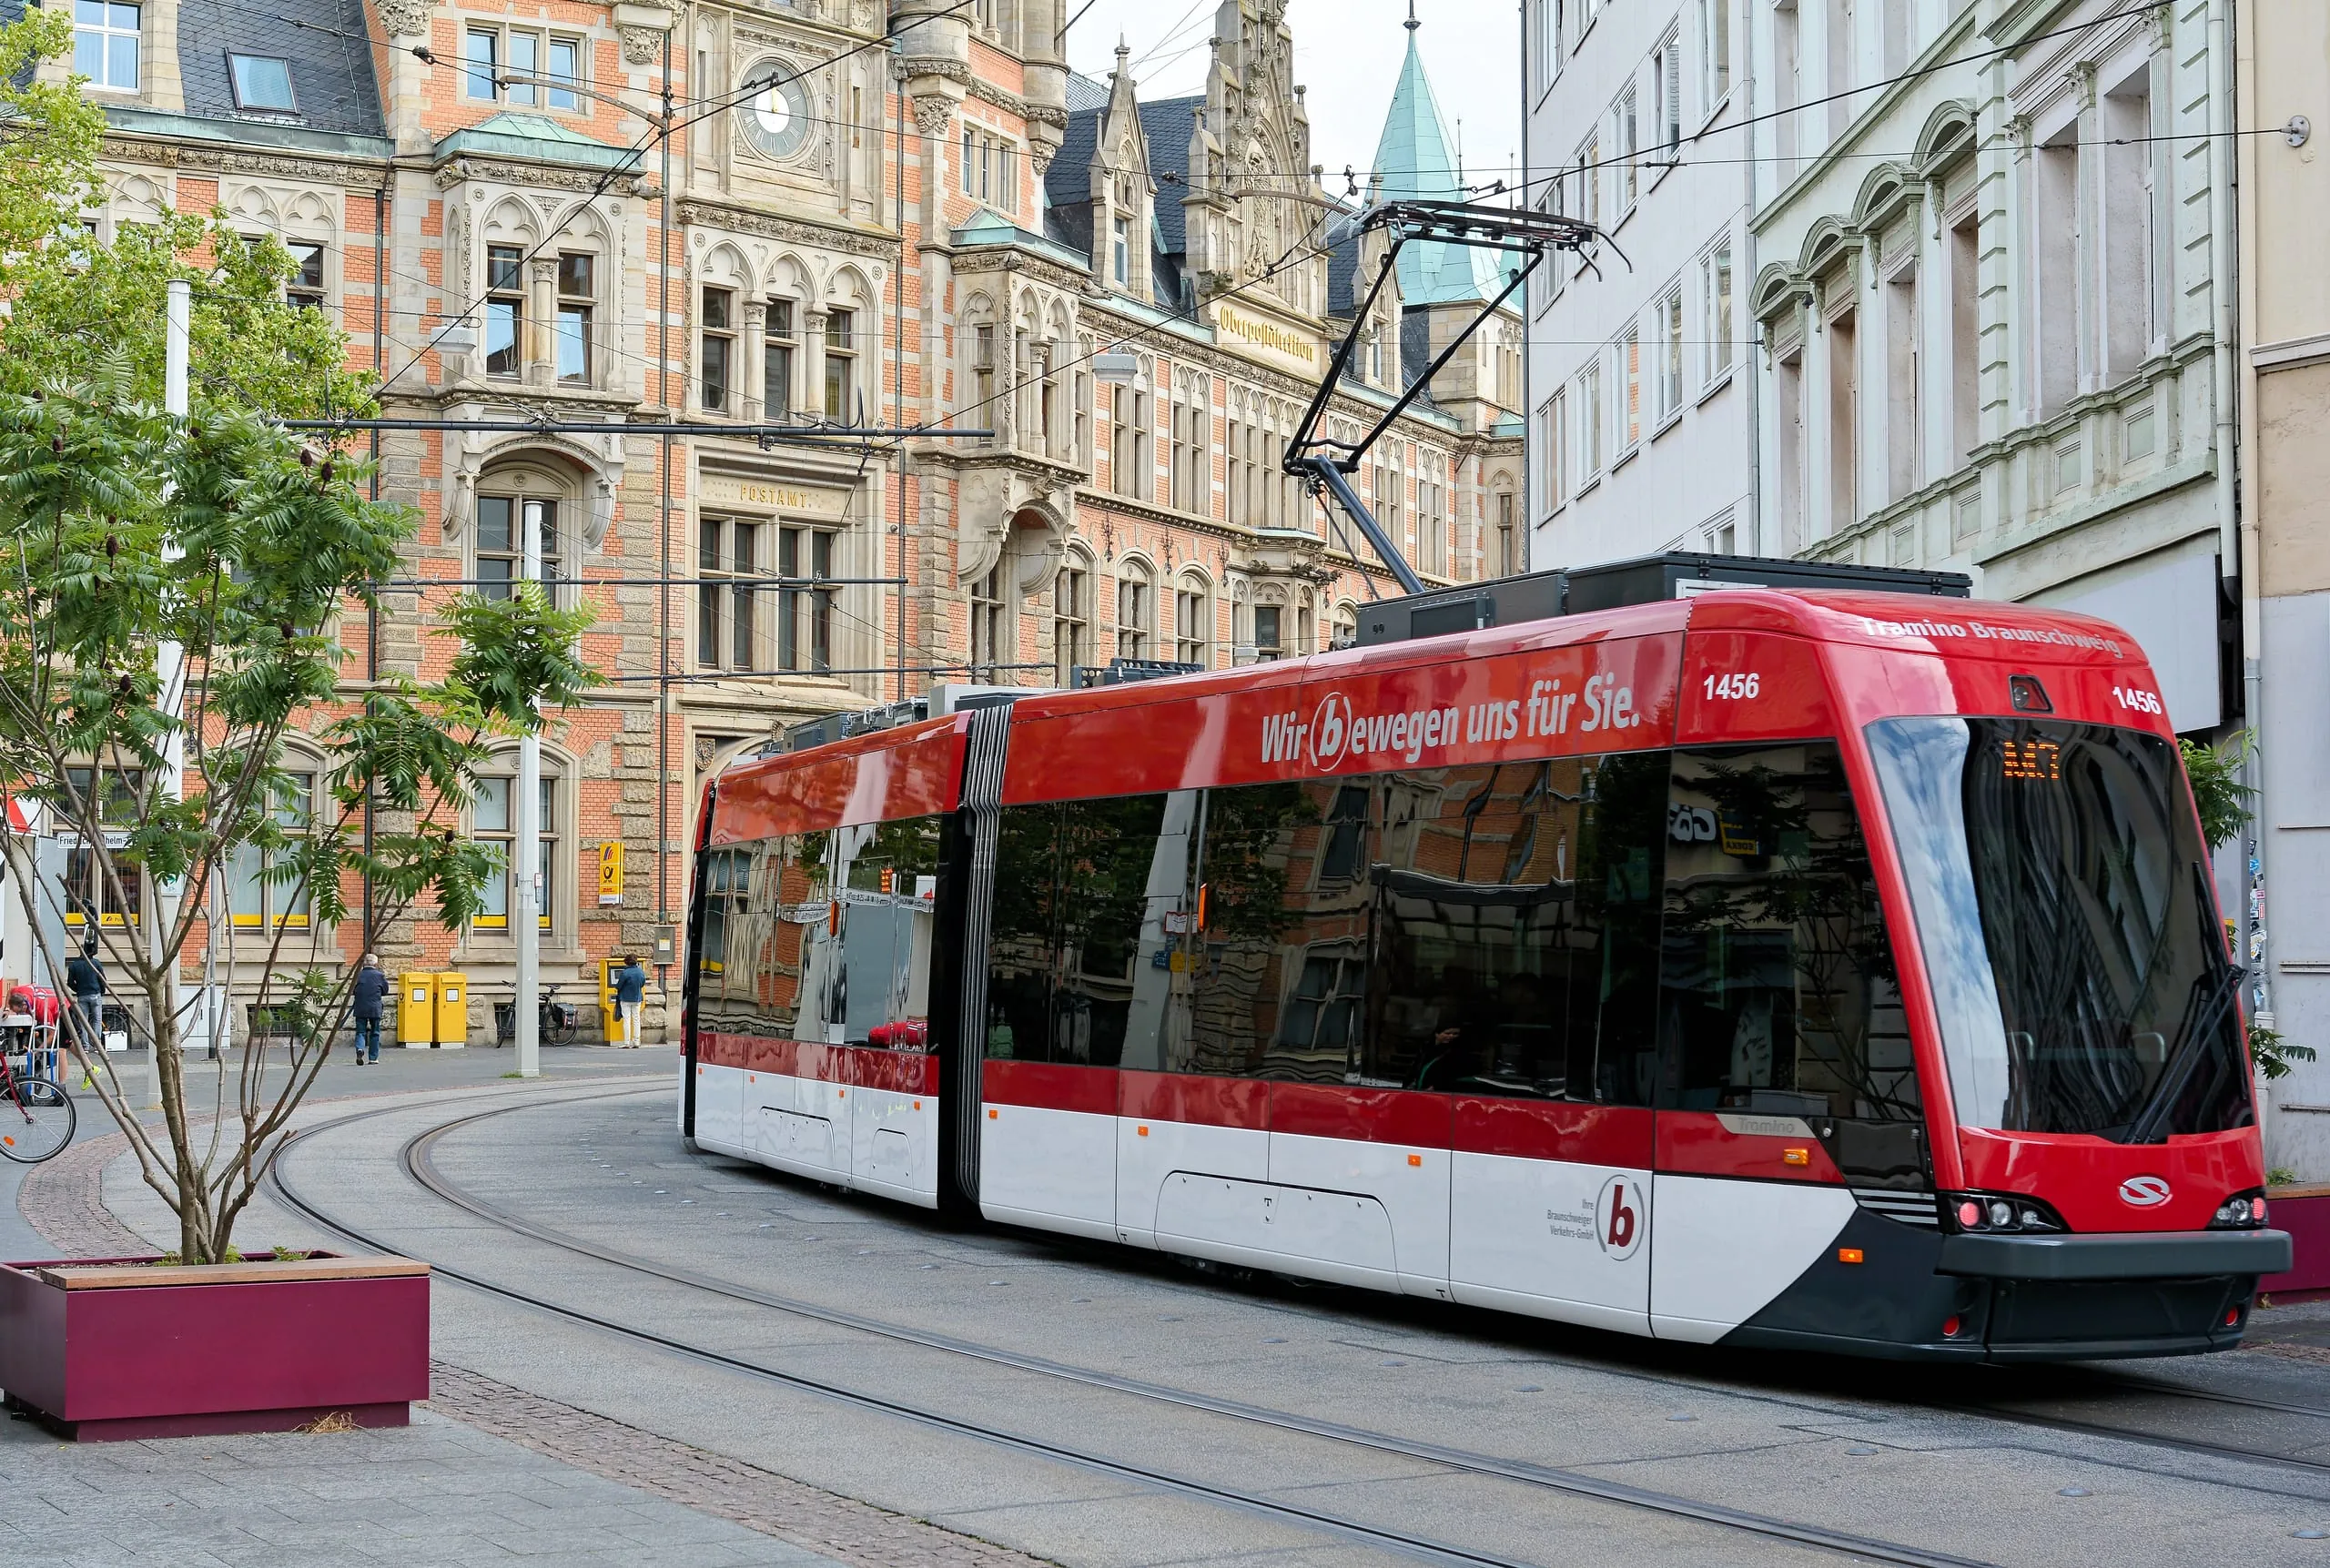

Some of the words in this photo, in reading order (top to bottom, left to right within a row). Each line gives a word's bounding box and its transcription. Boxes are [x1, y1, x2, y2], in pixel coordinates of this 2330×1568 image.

[741, 484, 807, 508] POSTAMT
[1857, 617, 1967, 637] Tramino
[1967, 622, 2123, 658] Braunschweig
[1703, 673, 1760, 700] 1456
[2112, 686, 2163, 714] 1456
[1261, 711, 1307, 764] Wir
[1466, 700, 1520, 744] uns
[1527, 679, 1576, 737] für
[1581, 672, 1640, 732] Sie.
[1737, 1117, 1795, 1133] Tramino
[1547, 1209, 1593, 1227] Braunschweiger
